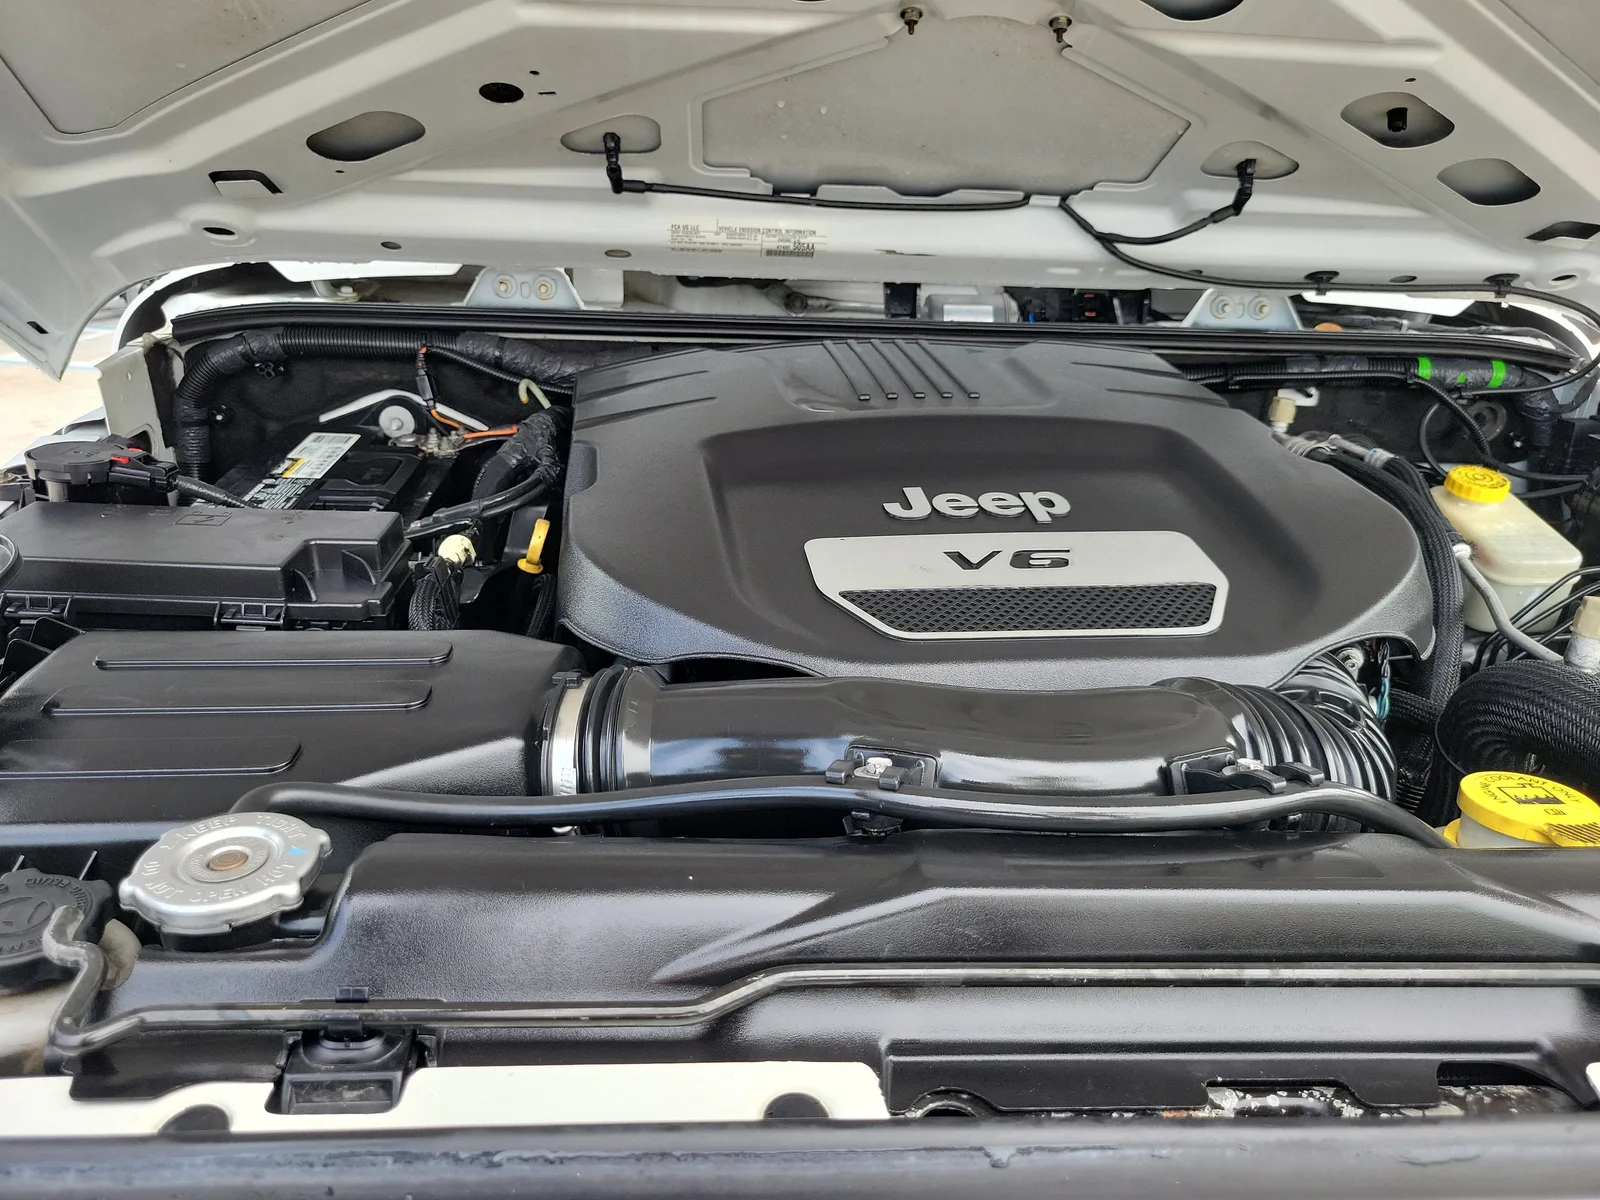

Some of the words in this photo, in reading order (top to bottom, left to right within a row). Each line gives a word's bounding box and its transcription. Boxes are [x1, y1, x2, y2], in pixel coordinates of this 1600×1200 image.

[882, 487, 1071, 524] Jeep
[943, 549, 1071, 570] V6
[1484, 774, 1548, 786] COOLANT
[1551, 786, 1582, 803] ONLY
[256, 815, 306, 838] TIGHT
[145, 880, 184, 899] NOT
[189, 885, 249, 902] OPEN
[256, 861, 295, 886] HOT
